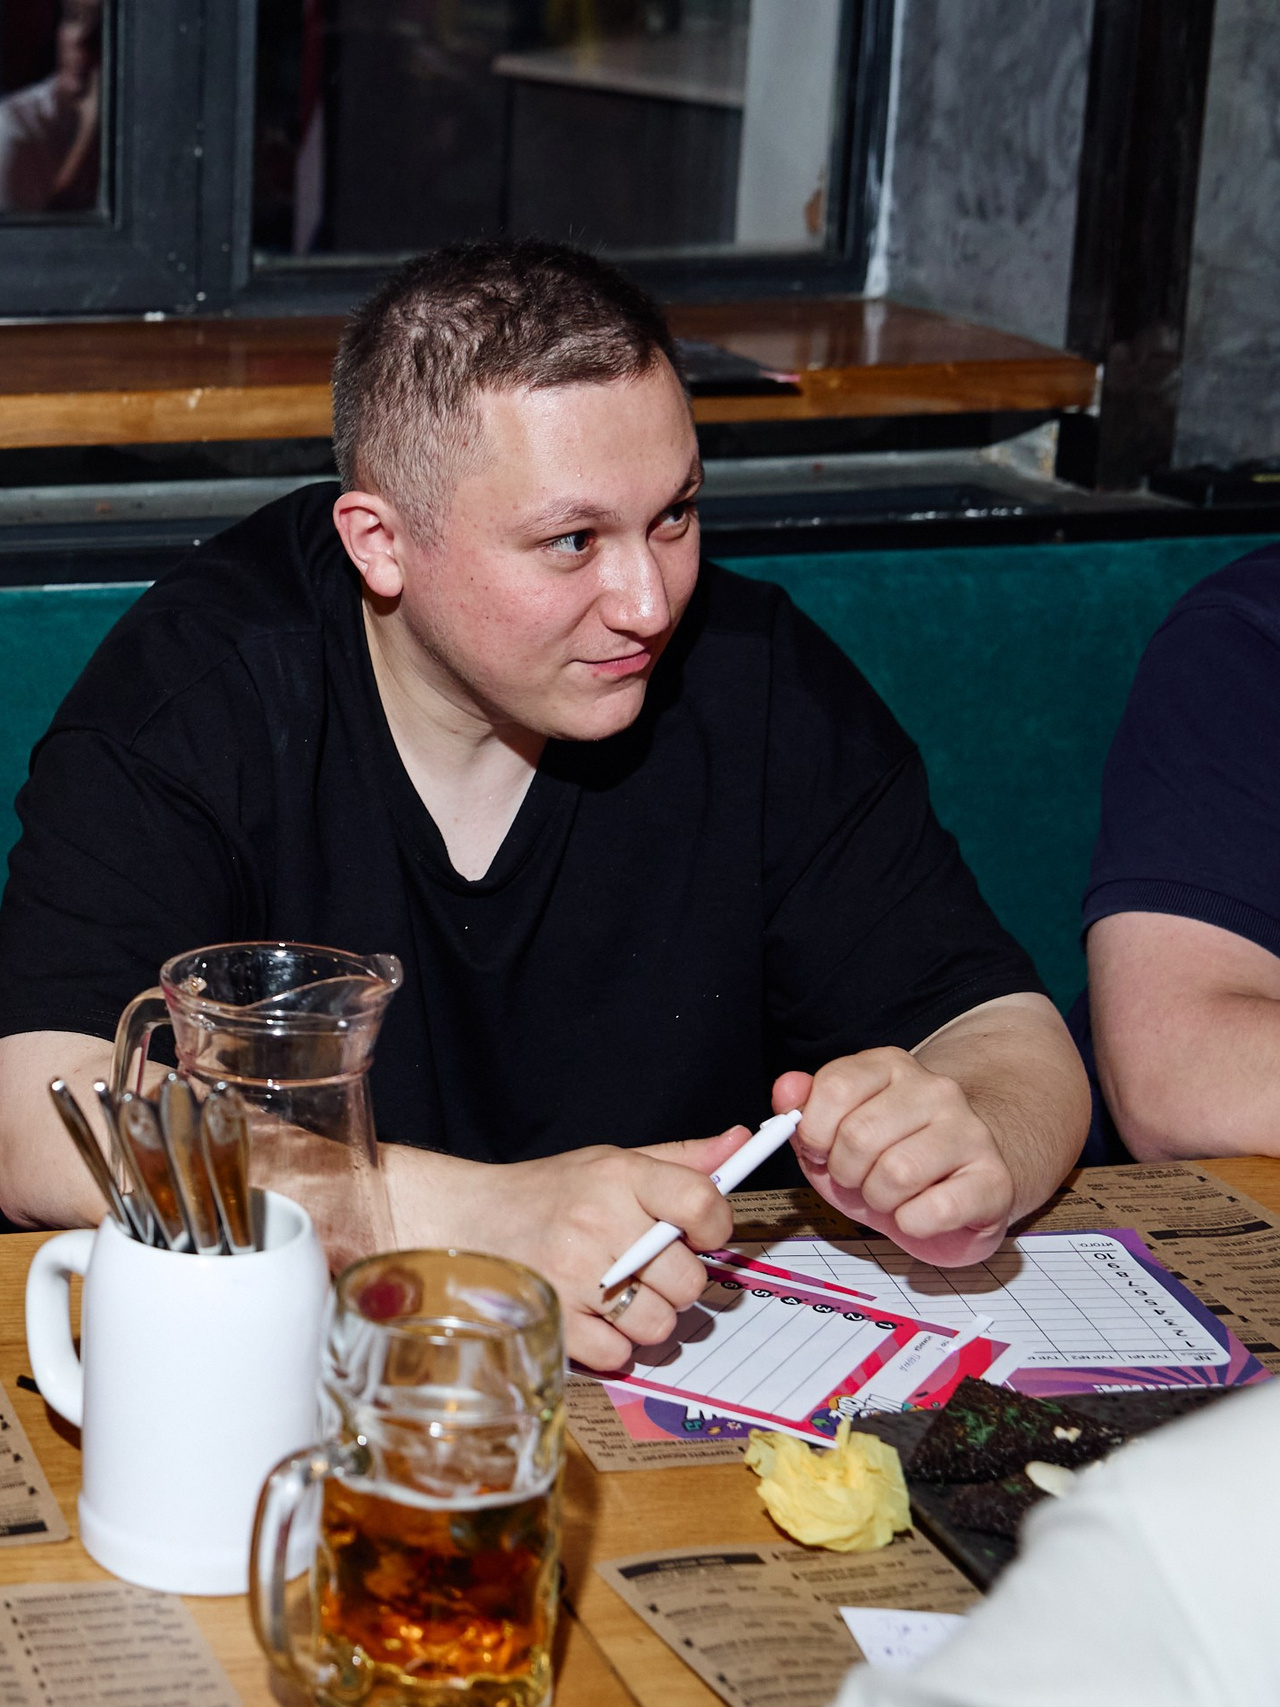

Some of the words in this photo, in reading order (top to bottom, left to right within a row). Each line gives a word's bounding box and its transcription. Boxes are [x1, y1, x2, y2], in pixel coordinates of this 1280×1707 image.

[1093, 1252, 1116, 1260] 10
[1144, 1298, 1157, 1306] 5
[1163, 1318, 1177, 1326] 3
[1172, 1329, 1188, 1337] 2
[1185, 1340, 1195, 1348] 1
